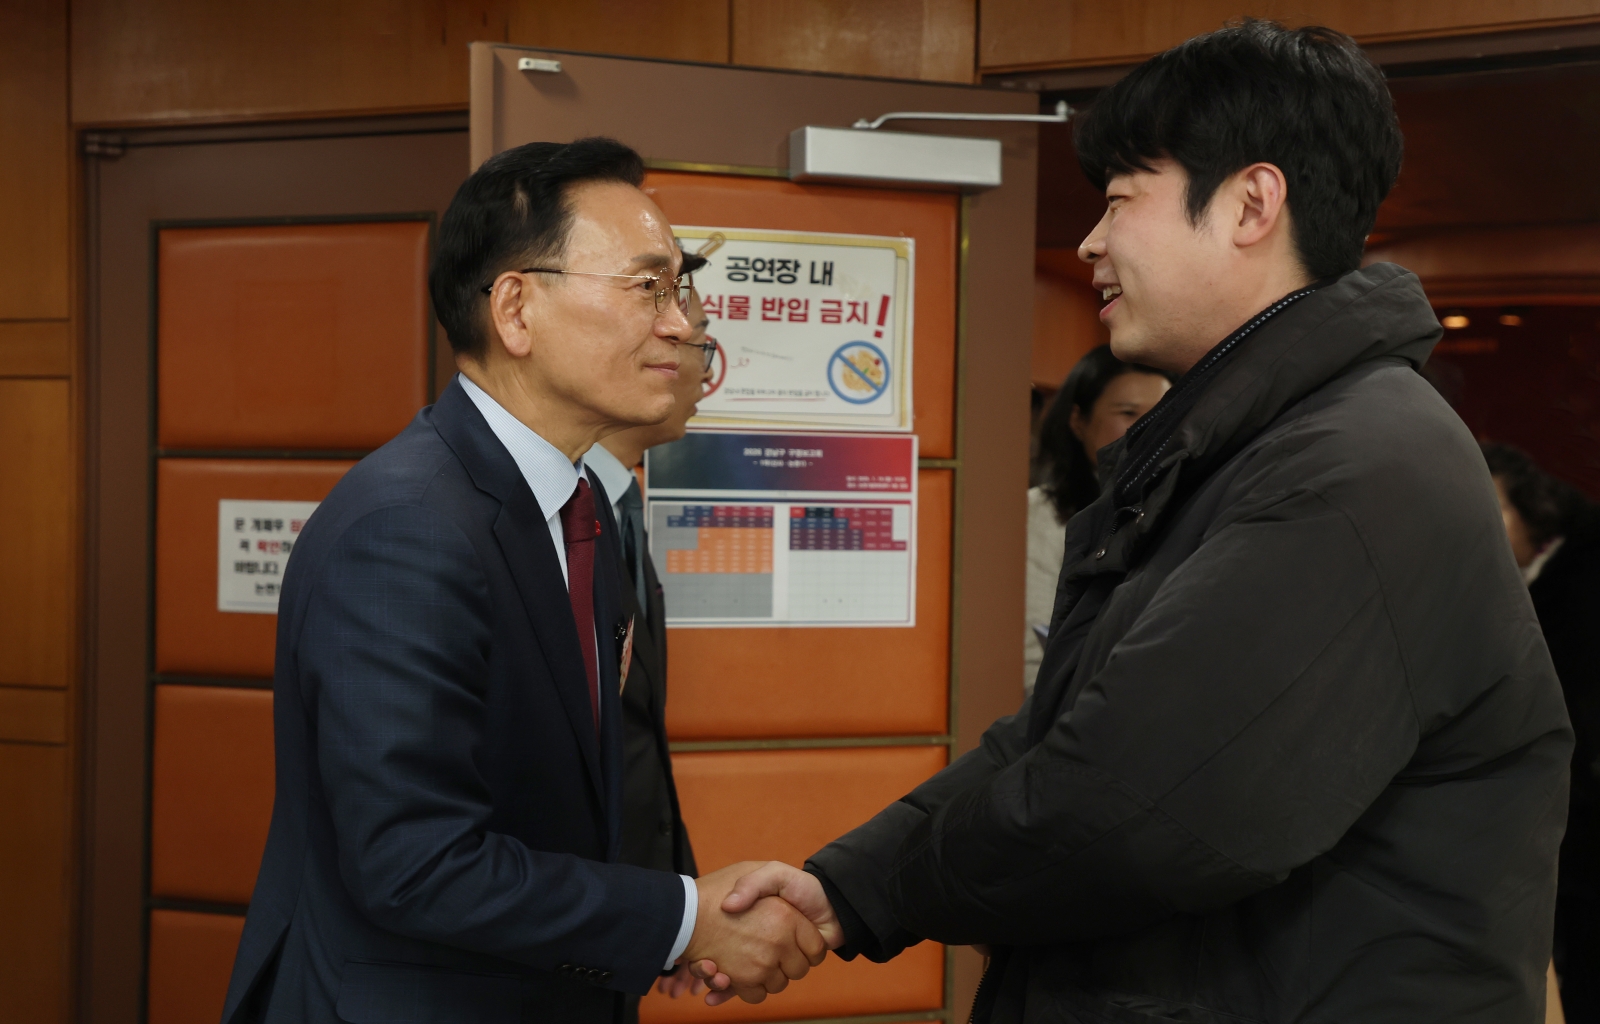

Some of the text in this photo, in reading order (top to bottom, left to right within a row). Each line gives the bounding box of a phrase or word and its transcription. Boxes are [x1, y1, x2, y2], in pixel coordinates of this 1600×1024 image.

[725, 256, 834, 286] 공연장 내
[761, 297, 809, 323] 반입
[820, 294, 891, 339] 금지!
